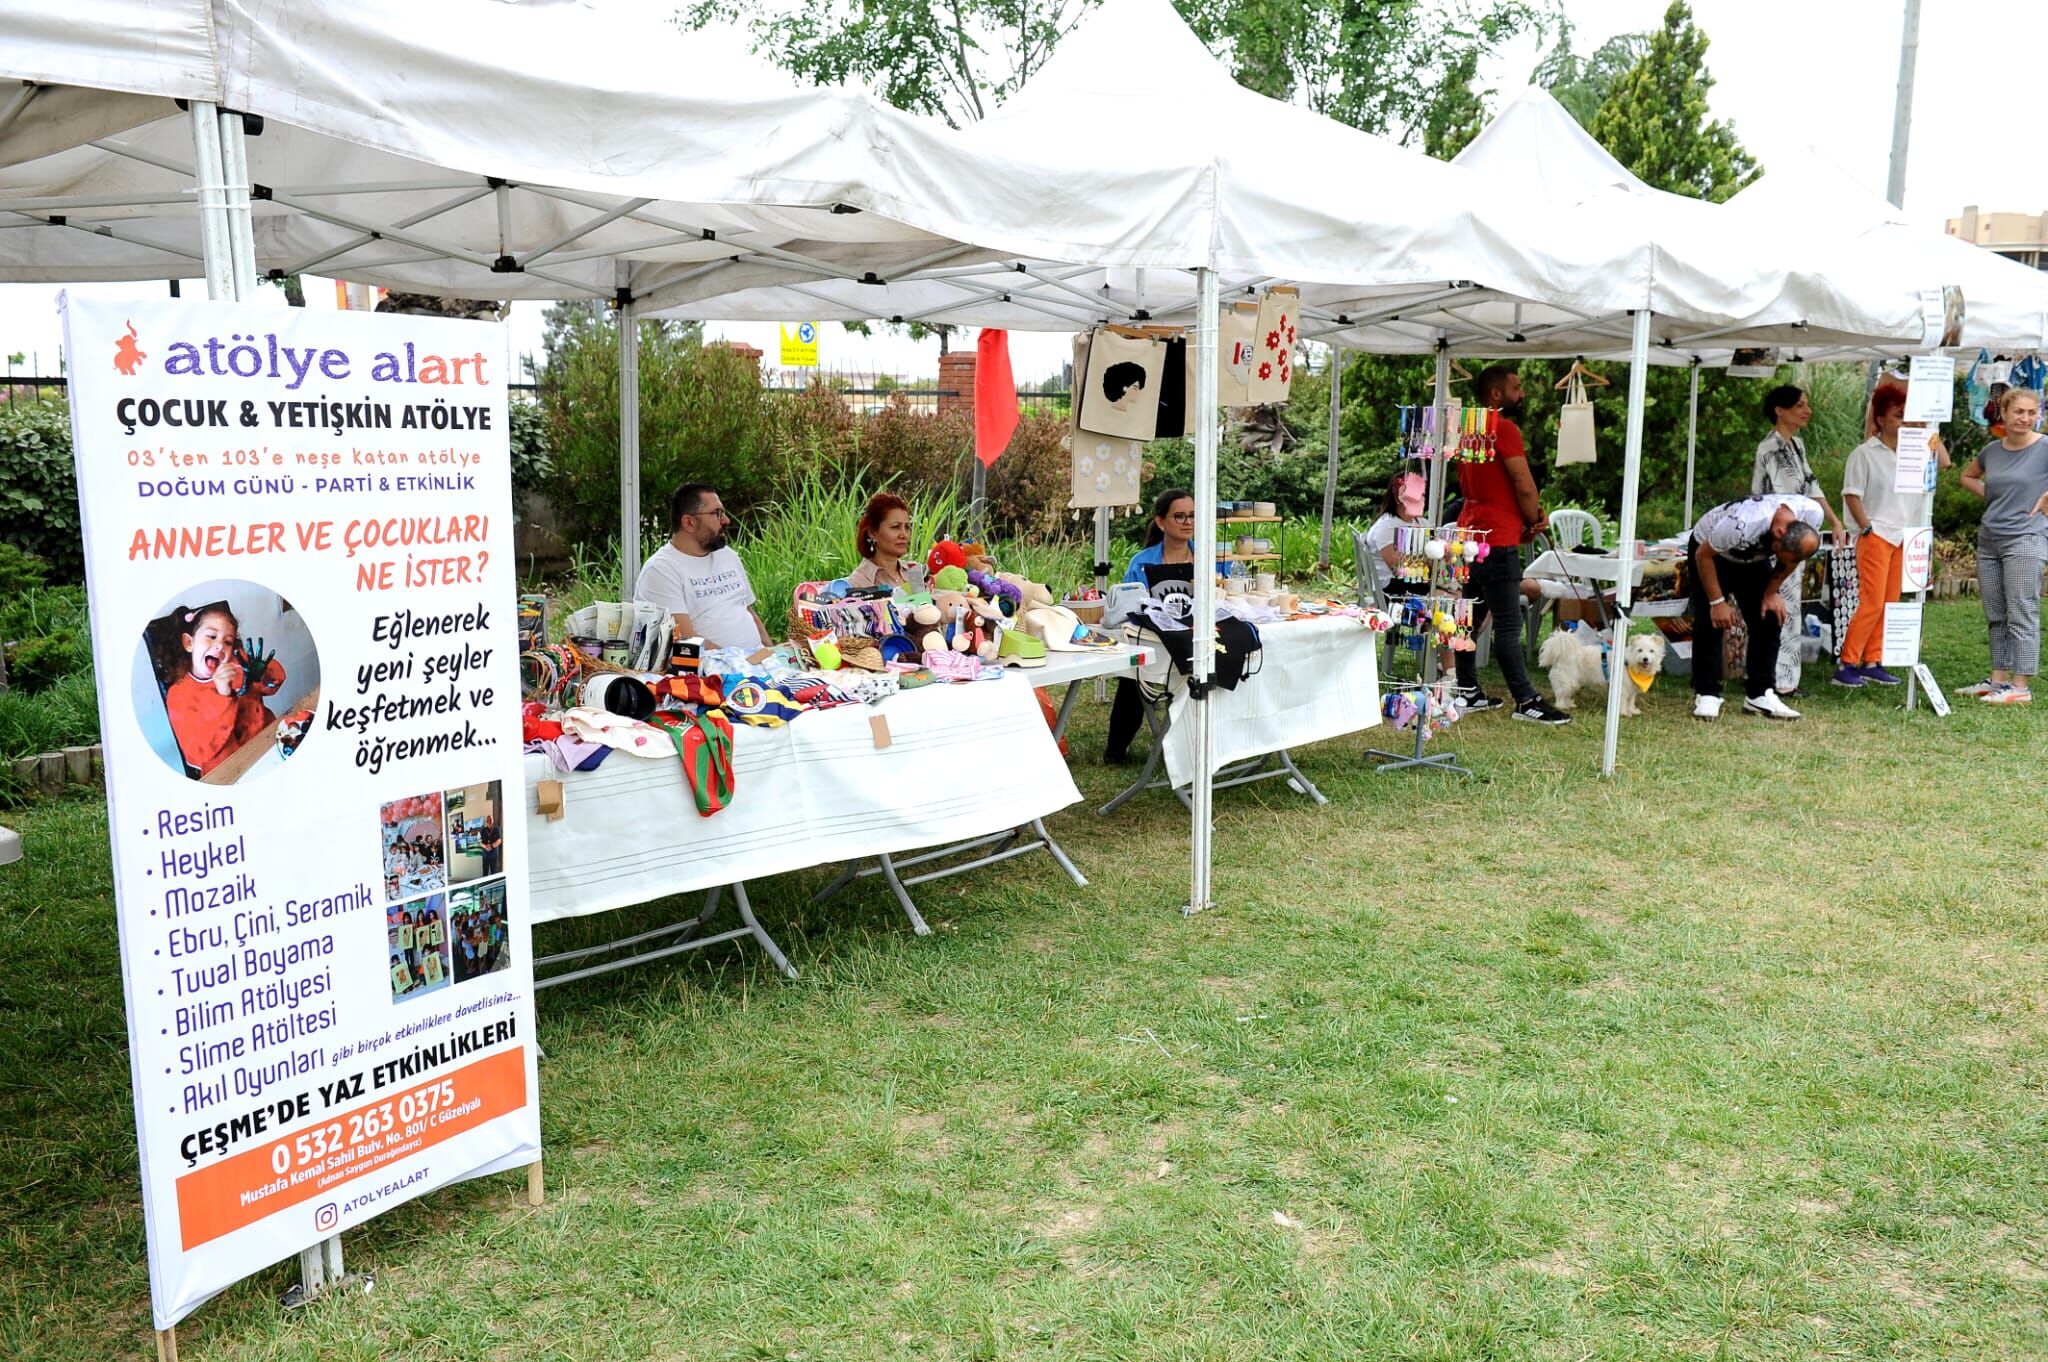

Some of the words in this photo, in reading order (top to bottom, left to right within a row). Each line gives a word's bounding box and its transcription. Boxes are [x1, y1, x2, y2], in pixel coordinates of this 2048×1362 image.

[164, 333, 351, 390] atölye
[371, 342, 489, 386] alart
[116, 398, 229, 435] ÇOCUK
[240, 402, 259, 428] &
[267, 394, 392, 436] YETİŞKİN
[401, 398, 491, 431] ATÖLYE
[222, 447, 284, 467] 103'e
[296, 452, 342, 469] neşe
[418, 448, 481, 466] atölye
[137, 475, 226, 498] DOĞUM
[234, 473, 295, 495] GÜNÜ
[315, 472, 373, 493] PARTİ
[379, 476, 391, 492] &
[396, 471, 475, 492] ETKİNLİK
[128, 521, 287, 561] ANNELER
[295, 519, 334, 551] VE
[343, 514, 489, 558] ÇOCUKLARI
[356, 562, 393, 592] NE
[404, 551, 489, 590] İSTER?
[372, 602, 490, 650] Eğlenerek
[357, 651, 414, 695] yeni
[422, 642, 494, 684] şeyler
[326, 683, 462, 735] keşfetmek
[469, 687, 494, 708] ve
[355, 720, 497, 775] öğrenmek...
[157, 802, 234, 839] Resim
[161, 835, 245, 879] Heykel
[165, 873, 257, 919] Mozaik
[169, 925, 229, 958] Ebru,
[234, 905, 281, 948] Çini,
[285, 882, 373, 927] Seramik
[244, 934, 334, 976] Boyama
[175, 1001, 234, 1037] Bilim
[241, 965, 331, 1017] Atölyesi
[179, 1037, 245, 1075] Slime
[252, 1000, 337, 1051] Atöltesi
[183, 1074, 227, 1115] Akıl
[234, 1048, 324, 1097] Oyunları
[332, 1044, 353, 1067] gibi
[357, 1031, 392, 1053] birçok
[395, 1012, 452, 1041] etkinliklere
[180, 1092, 310, 1168] ÇEŞME'DE
[318, 1072, 365, 1107] YAZ
[373, 1011, 516, 1090] ETKİNLİKLERİ
[272, 1144, 290, 1174] 0
[296, 1123, 344, 1166] 532
[348, 1103, 394, 1142] 263
[399, 1078, 455, 1123] 0375
[239, 1179, 289, 1207] Mustafa
[290, 1162, 325, 1186] Kemal
[327, 1150, 355, 1174] Sahil
[357, 1139, 384, 1161] Bulv.
[386, 1131, 404, 1147] No.
[430, 1115, 437, 1127] C
[438, 1096, 481, 1123] Güzelyalı
[317, 1171, 345, 1189] (Adnan
[345, 1160, 374, 1178] Saygun
[343, 1167, 430, 1215] ATOLYEALART
